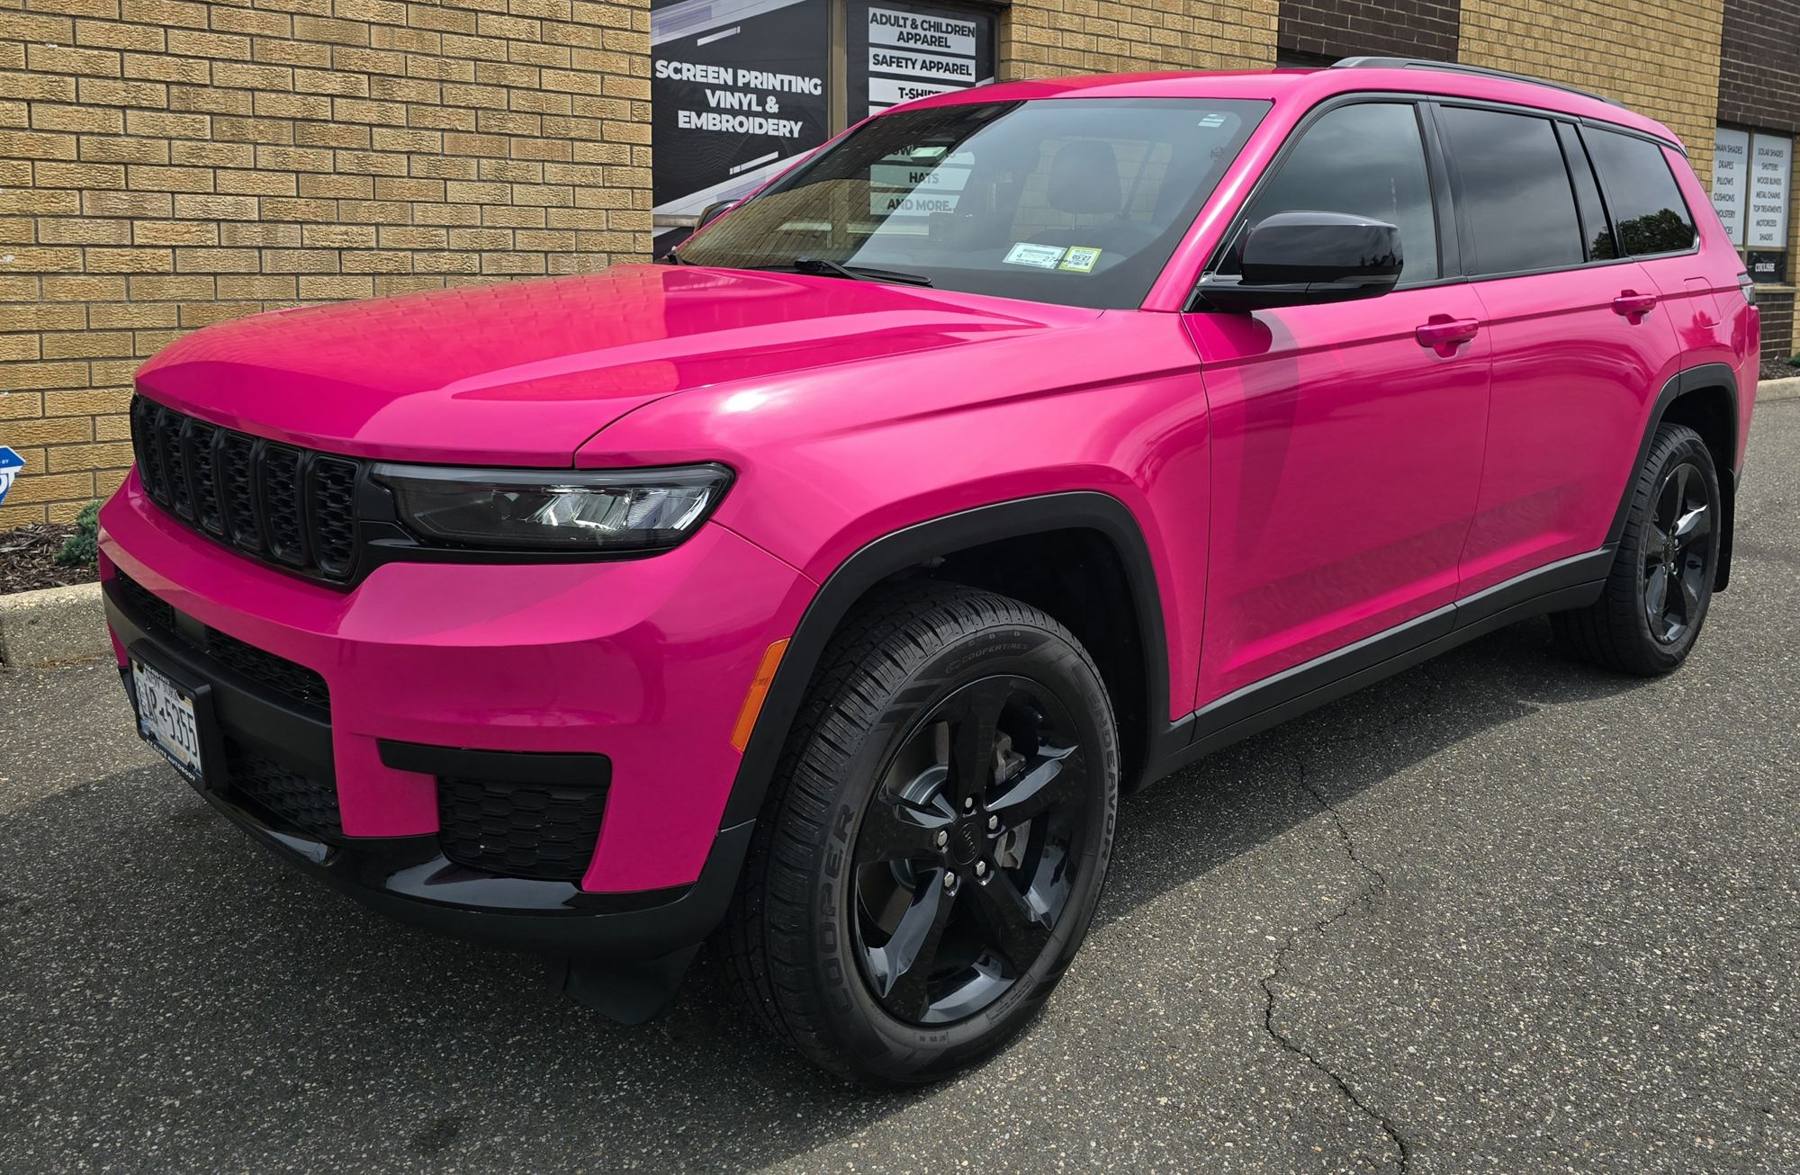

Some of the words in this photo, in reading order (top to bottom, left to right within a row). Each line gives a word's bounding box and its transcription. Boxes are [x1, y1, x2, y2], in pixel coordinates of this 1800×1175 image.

[870, 12, 909, 28] ADULT
[910, 18, 919, 30] &
[920, 20, 975, 38] CHILDREN
[897, 31, 951, 49] APPAREL
[872, 53, 918, 70] SAFETY
[919, 59, 972, 76] APPAREL
[655, 59, 733, 86] SCREEN
[737, 69, 822, 95] PRINTING
[705, 89, 762, 112] VINYL
[765, 96, 779, 114] &
[677, 110, 803, 139] EMBROIDERY
[1727, 145, 1743, 155] SHADES
[1718, 159, 1735, 170] DRAPES
[909, 172, 940, 184] HATS
[1716, 176, 1734, 186] PILLOWS
[887, 199, 914, 210] AND
[1713, 192, 1735, 202] CUSHIONS
